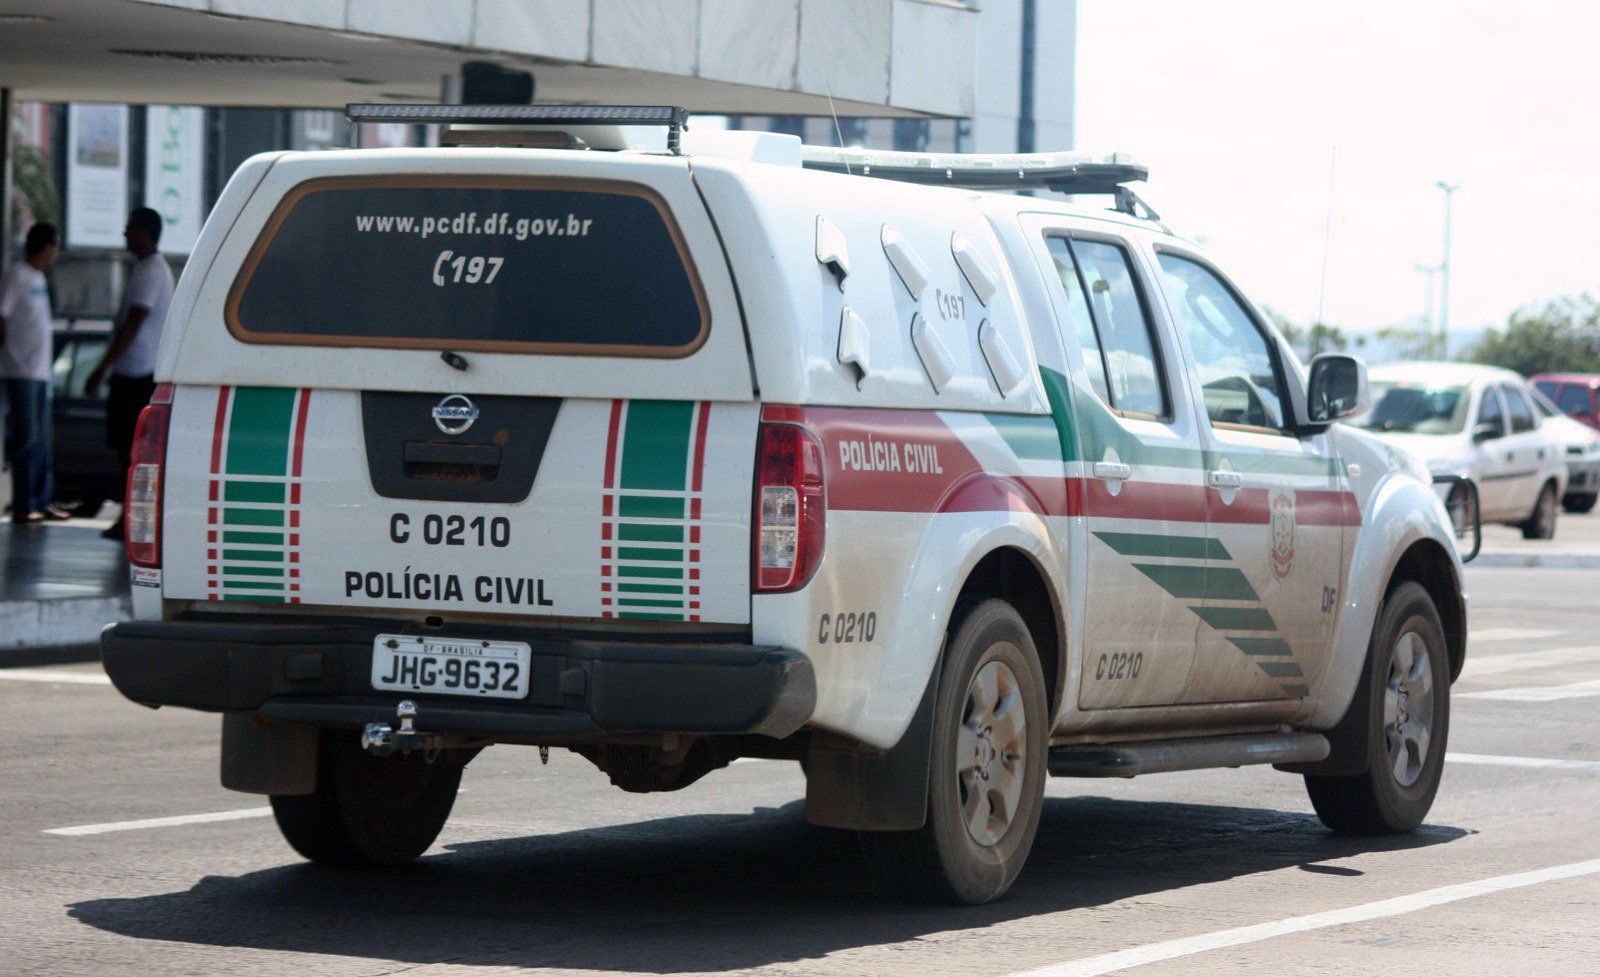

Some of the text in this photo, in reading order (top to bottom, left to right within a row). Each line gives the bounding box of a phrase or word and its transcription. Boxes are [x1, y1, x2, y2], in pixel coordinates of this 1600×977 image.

[356, 212, 593, 240] www.pcdf.df.gov.br
[451, 256, 504, 284] 197
[944, 294, 965, 320] 197
[839, 433, 943, 474] POLÍCIA CIVIL
[390, 513, 511, 547] C 0210
[345, 566, 553, 606] POLÍCIA CIVIL
[1322, 586, 1336, 613] DF
[818, 611, 876, 644] C 0210
[1096, 652, 1143, 680] C 0210
